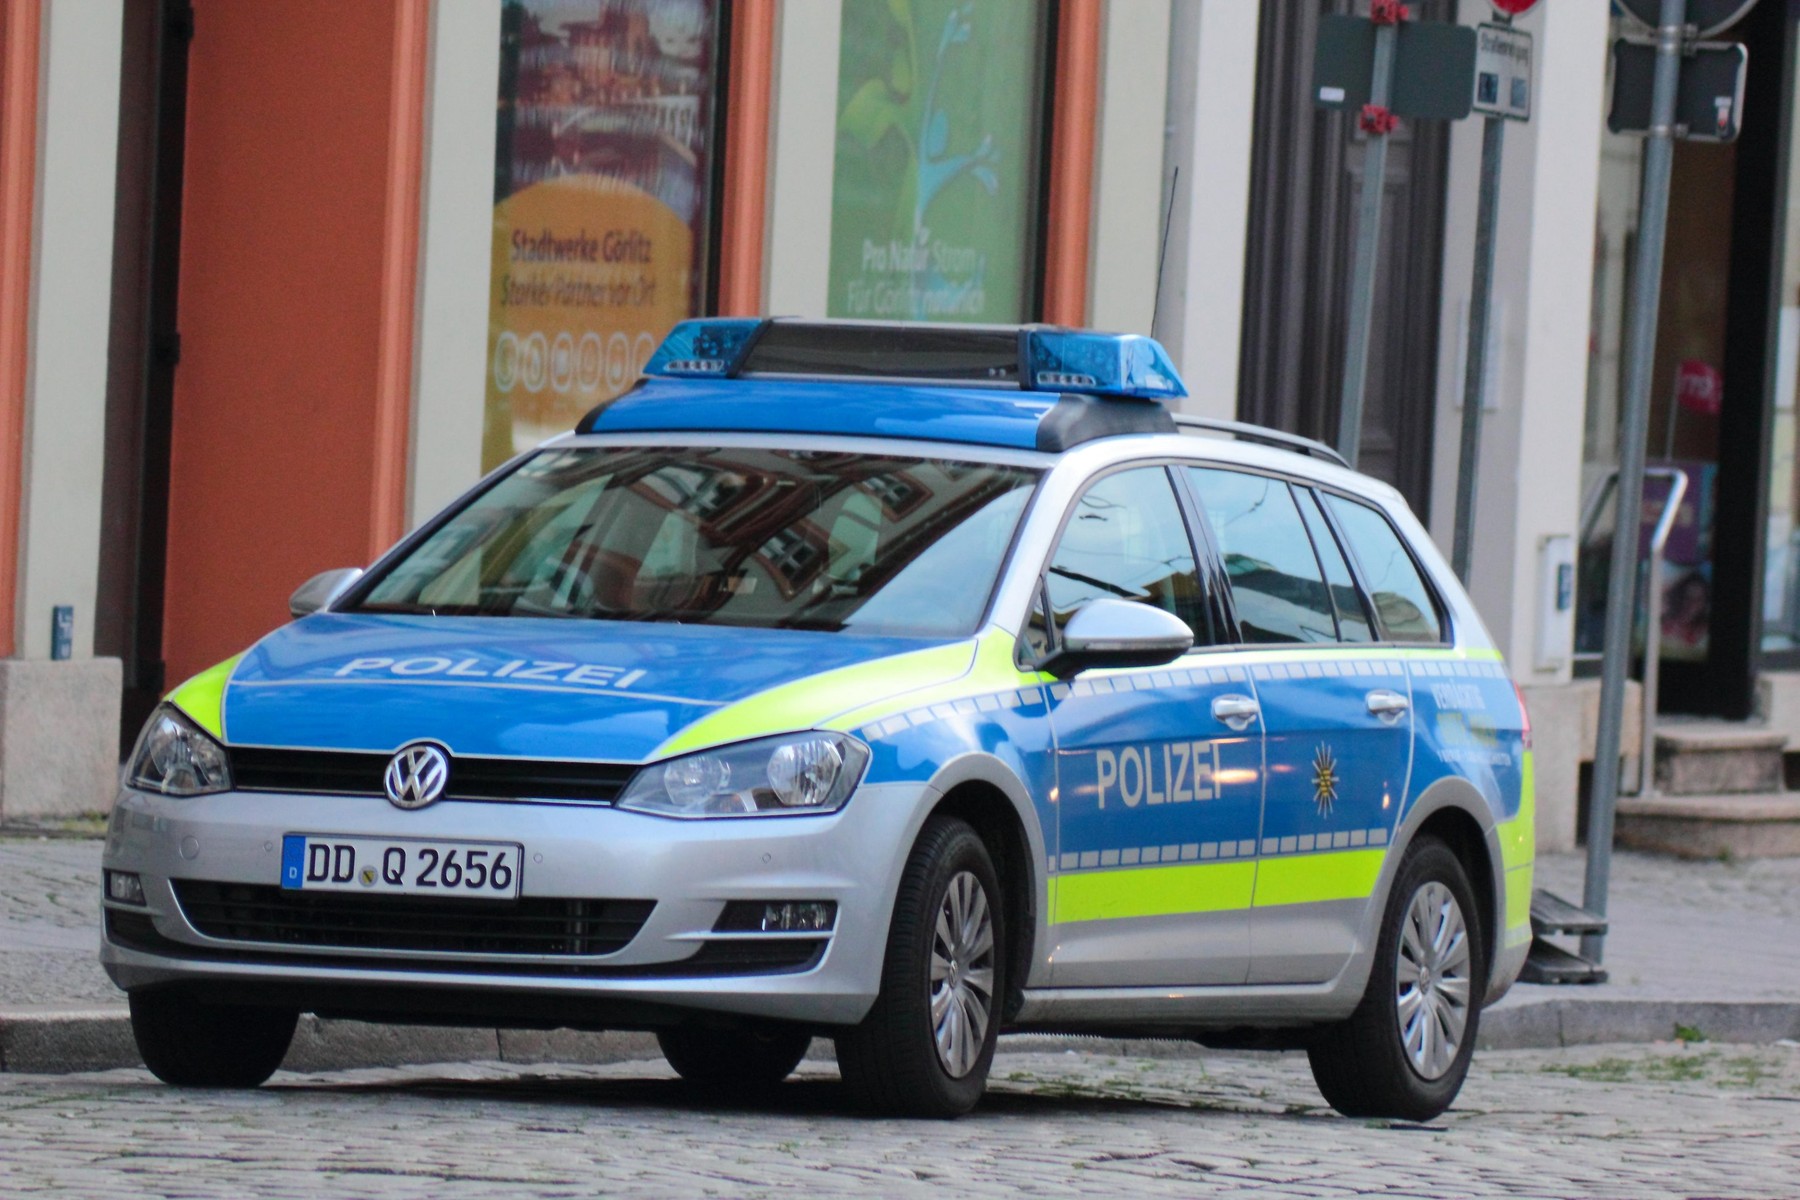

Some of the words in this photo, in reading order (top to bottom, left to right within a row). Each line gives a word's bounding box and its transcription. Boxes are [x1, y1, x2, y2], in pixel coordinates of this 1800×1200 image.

[511, 228, 598, 262] Stadtwerke
[602, 229, 652, 263] Görlitz
[862, 238, 888, 272] Pro
[334, 656, 648, 689] POLIZEI
[385, 744, 447, 808] VW
[1096, 740, 1220, 810] POLIZEI
[288, 866, 298, 879] D
[306, 843, 356, 883] DD
[382, 846, 407, 886] Q
[415, 848, 513, 890] 2656
